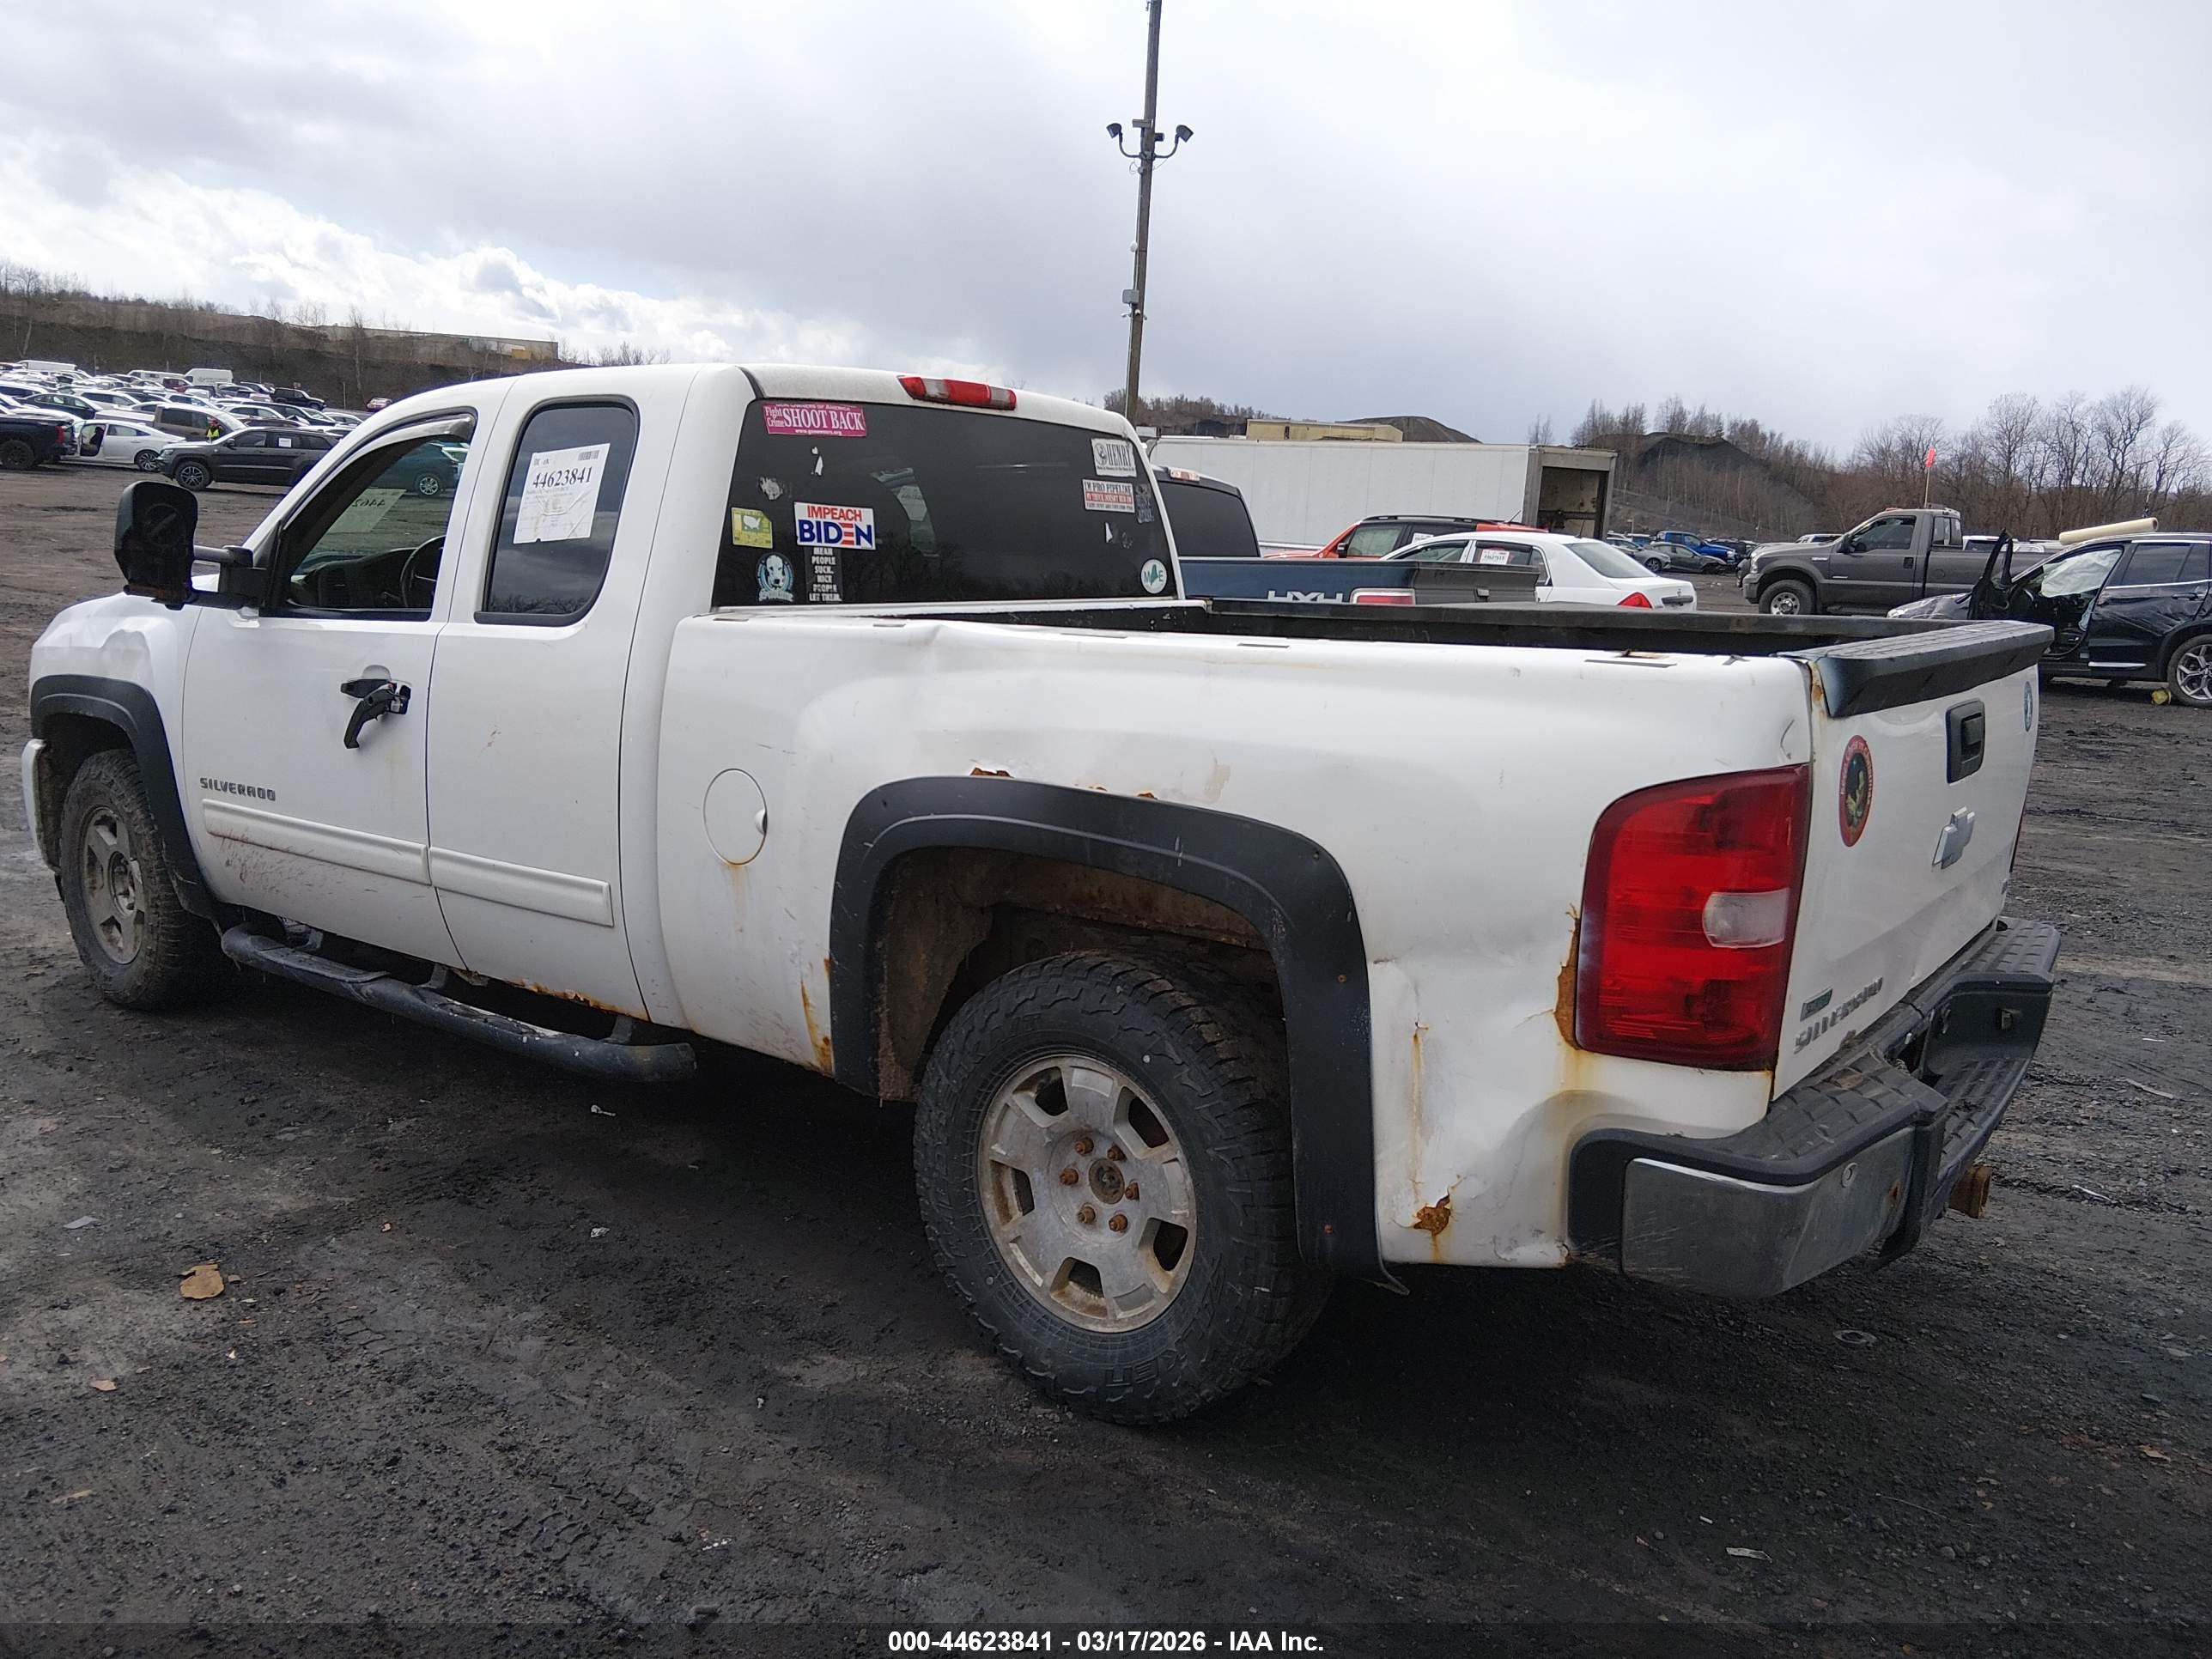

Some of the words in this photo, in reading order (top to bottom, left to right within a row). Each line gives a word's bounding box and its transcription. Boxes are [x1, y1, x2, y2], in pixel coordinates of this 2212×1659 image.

[765, 407, 783, 419] Fight
[782, 408, 828, 428] SHOOT
[830, 410, 865, 431] BACK
[1106, 443, 1132, 467] HENRY
[532, 466, 592, 489] 44623841
[807, 505, 862, 522] IMPEACH
[798, 519, 872, 548] BIDEN
[811, 556, 836, 565] PEOPLE
[812, 584, 838, 592] PEOPLE
[200, 777, 276, 802] SILVERADO
